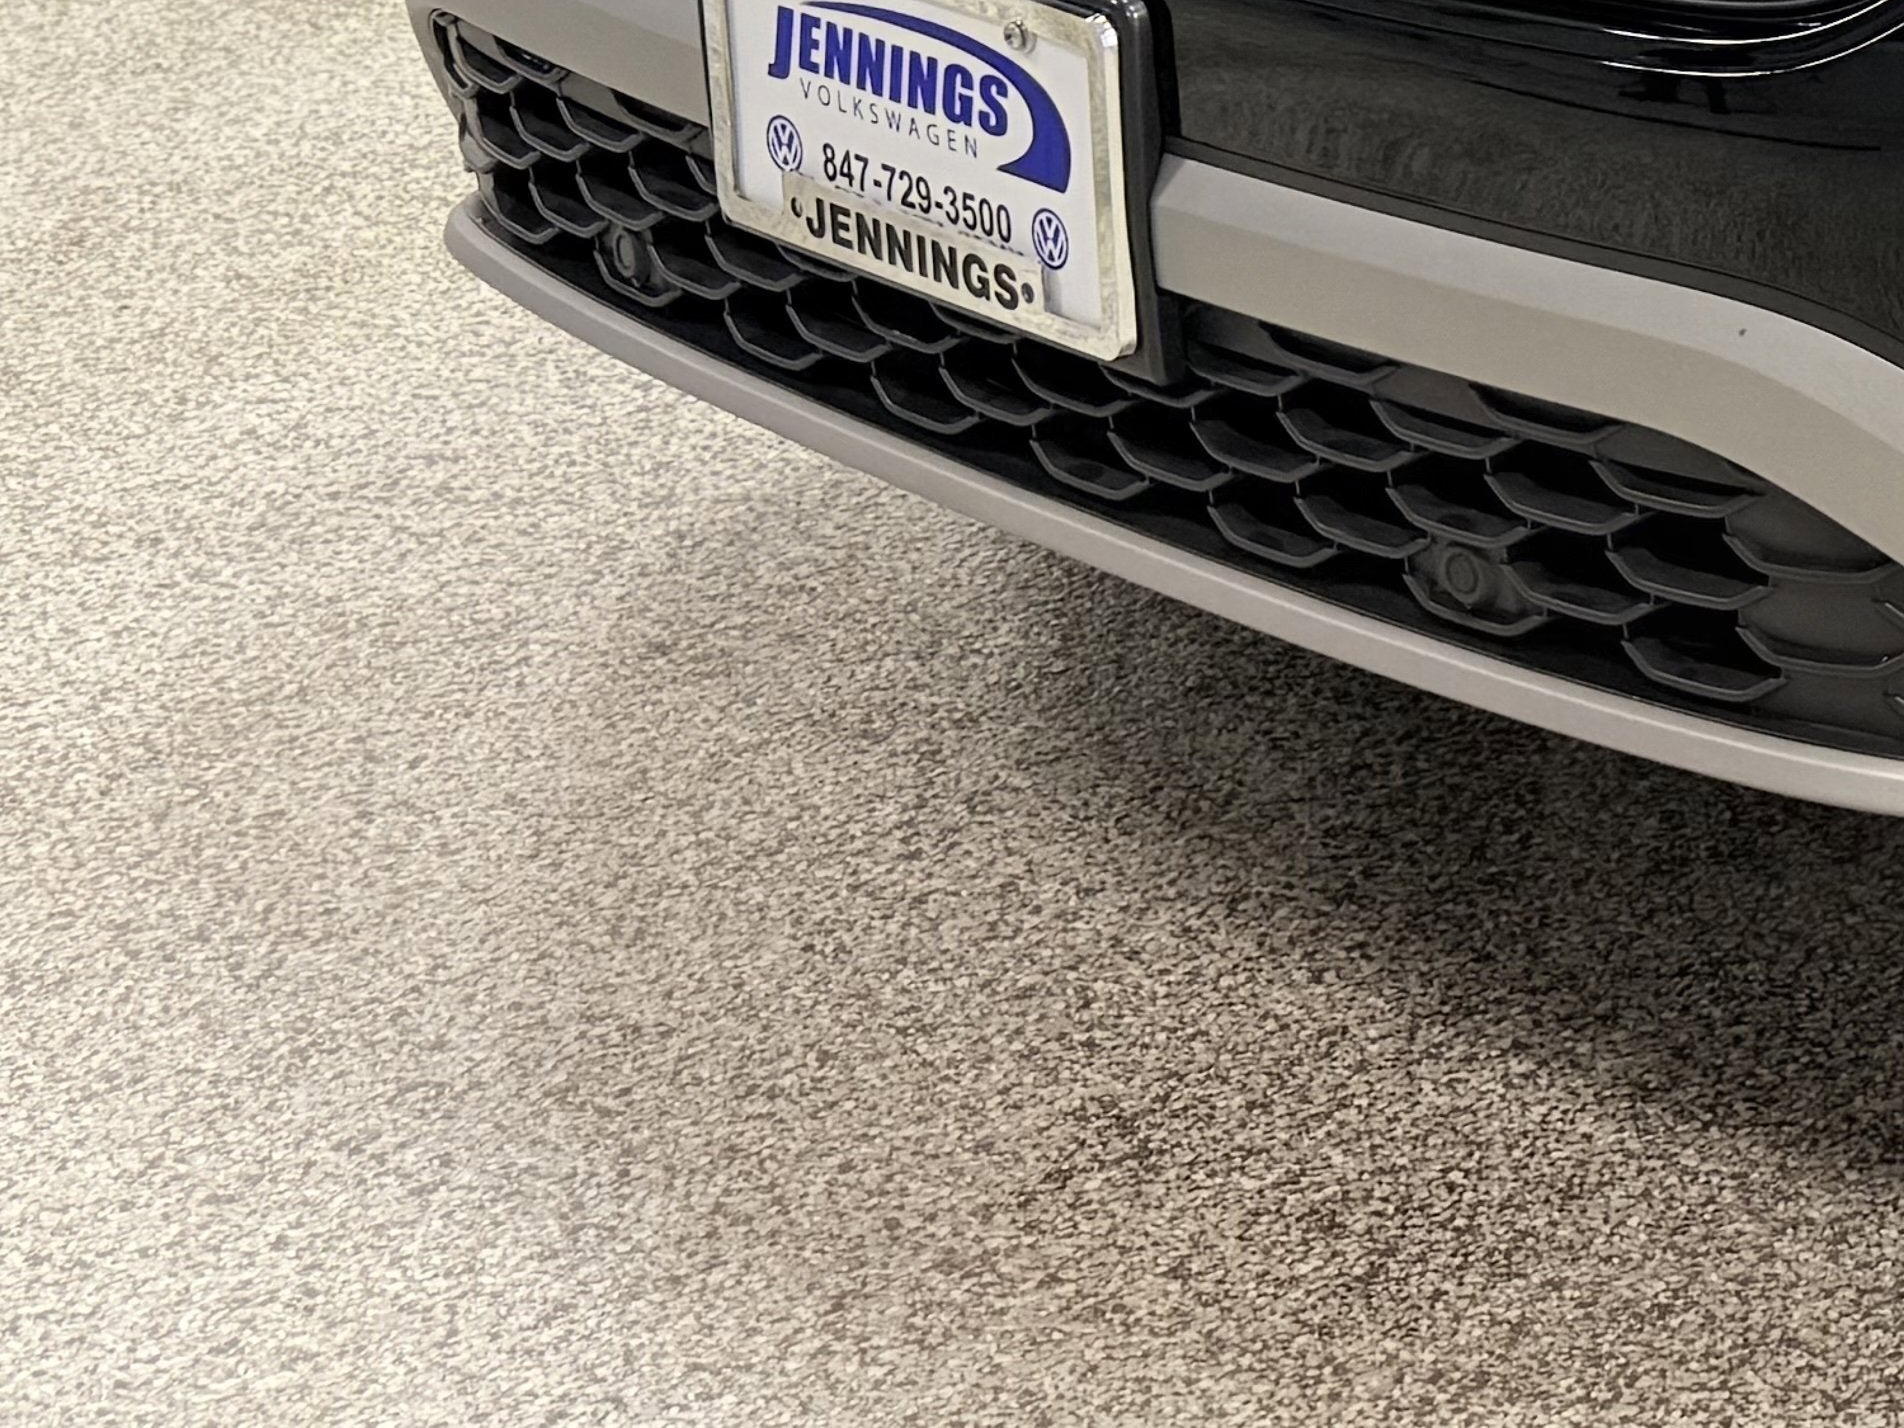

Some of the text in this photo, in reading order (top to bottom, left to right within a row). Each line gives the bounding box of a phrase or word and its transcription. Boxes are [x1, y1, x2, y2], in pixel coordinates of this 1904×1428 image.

[768, 5, 1009, 137] JENNINGS
[799, 80, 979, 159] VOLKSWAGEN
[822, 142, 1012, 244] 847-729-3500
[806, 196, 1019, 311] JENNINGS
